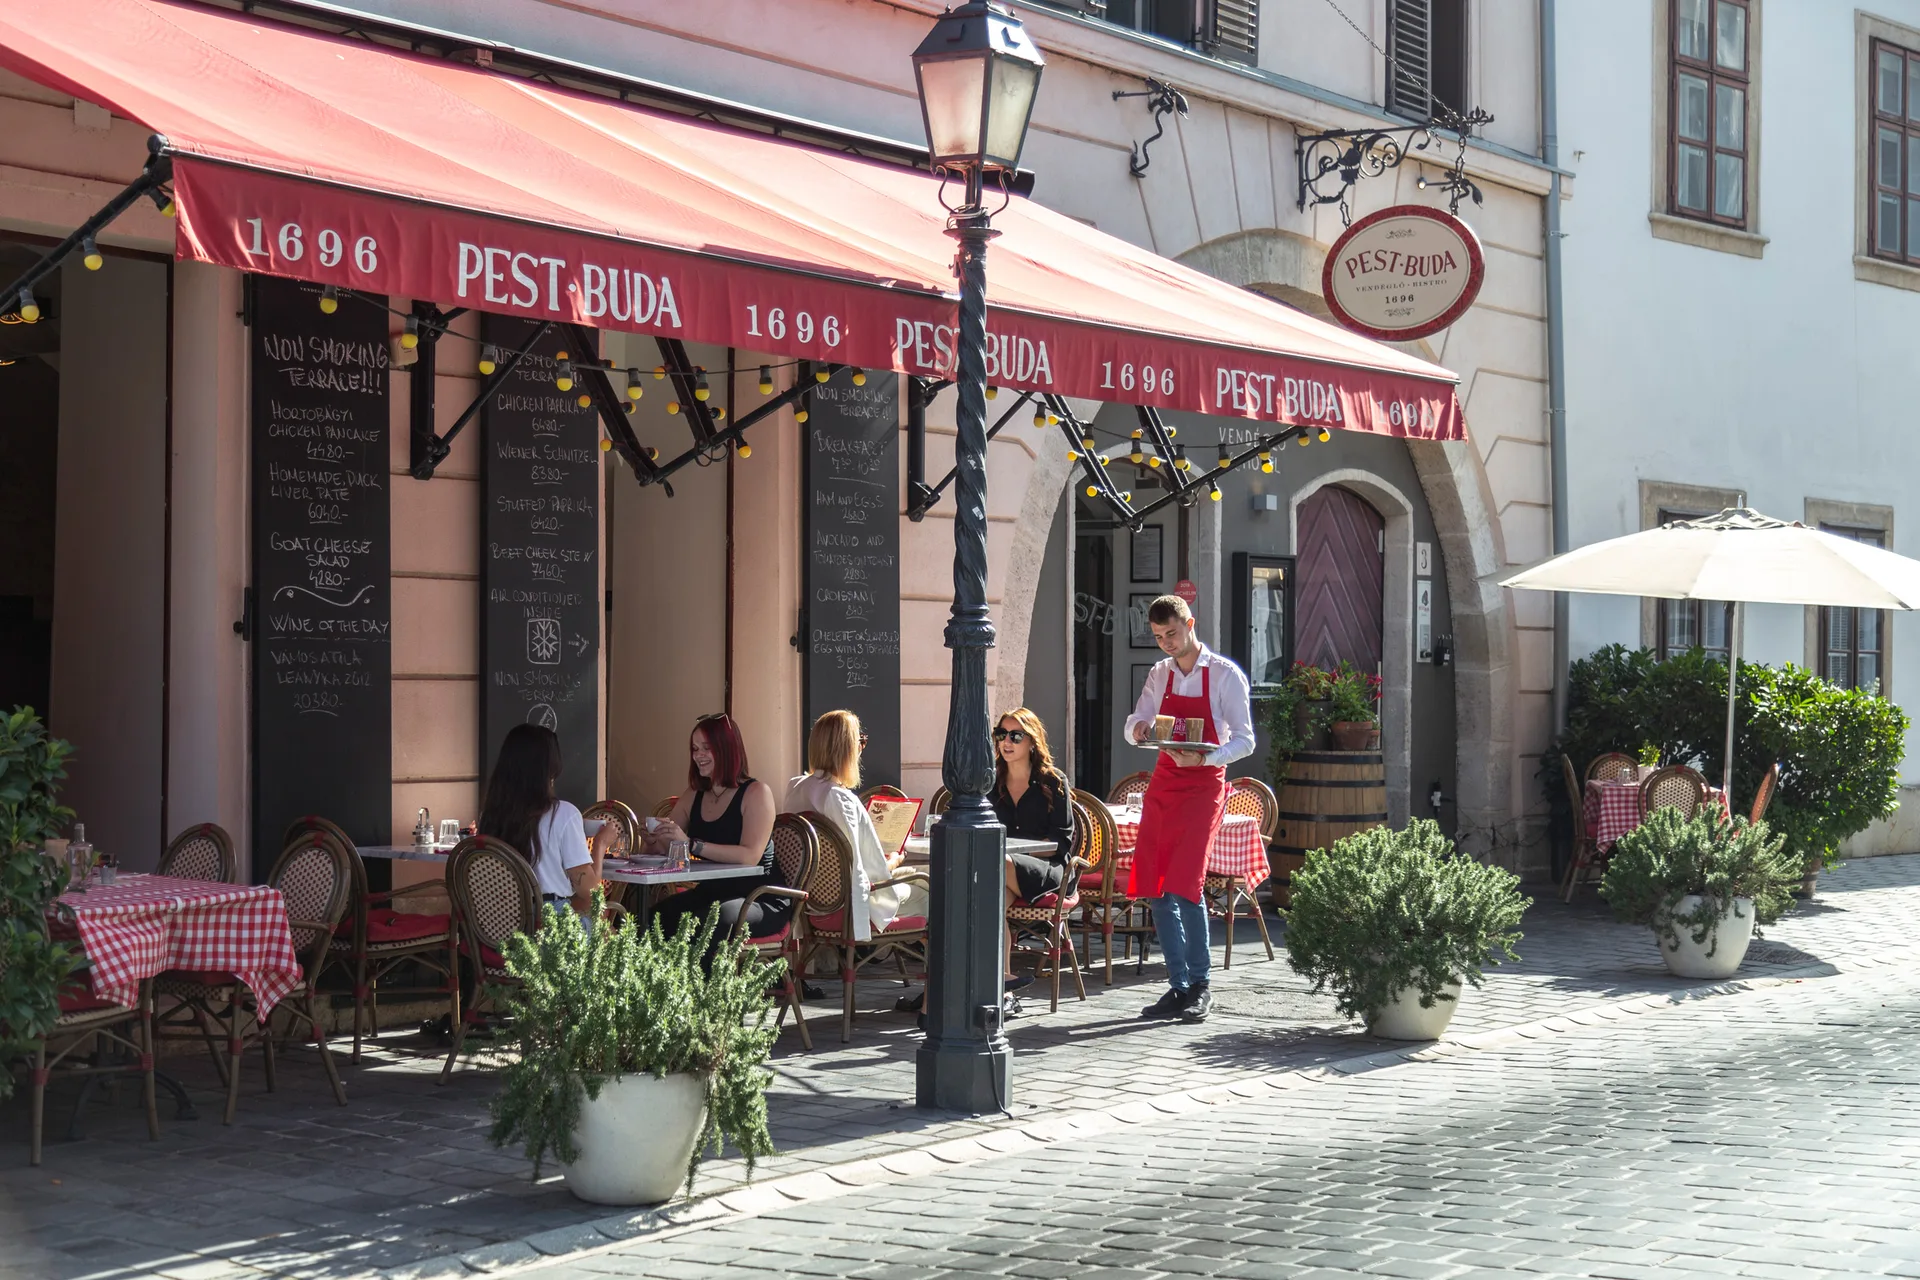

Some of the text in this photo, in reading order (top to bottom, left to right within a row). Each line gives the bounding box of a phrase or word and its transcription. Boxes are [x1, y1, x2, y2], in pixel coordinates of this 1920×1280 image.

[246, 217, 379, 274] 1696
[1412, 279, 1447, 288] BISTRO
[1385, 294, 1414, 304] 1696
[746, 304, 841, 347] 1696
[263, 333, 388, 369] NON SMOKING
[1100, 361, 1175, 396] 1696
[497, 394, 543, 412] CHICKEN
[816, 385, 891, 404] NON SMOKING
[268, 424, 381, 443] CHICKEN PANCAKE
[497, 442, 542, 460] WIENER
[346, 470, 382, 490] DUCK
[271, 484, 313, 500] LIVER
[816, 490, 835, 506] HAM
[497, 495, 545, 512] STUFFED
[271, 532, 372, 554] GOAT CHEESE
[306, 554, 350, 567] SALAD
[1420, 548, 1428, 570] 3
[491, 588, 510, 603] AIR
[269, 613, 314, 633] WINE
[362, 619, 389, 634] DAY
[813, 643, 833, 654] EGG
[857, 643, 864, 655] 3
[836, 655, 845, 669] 3
